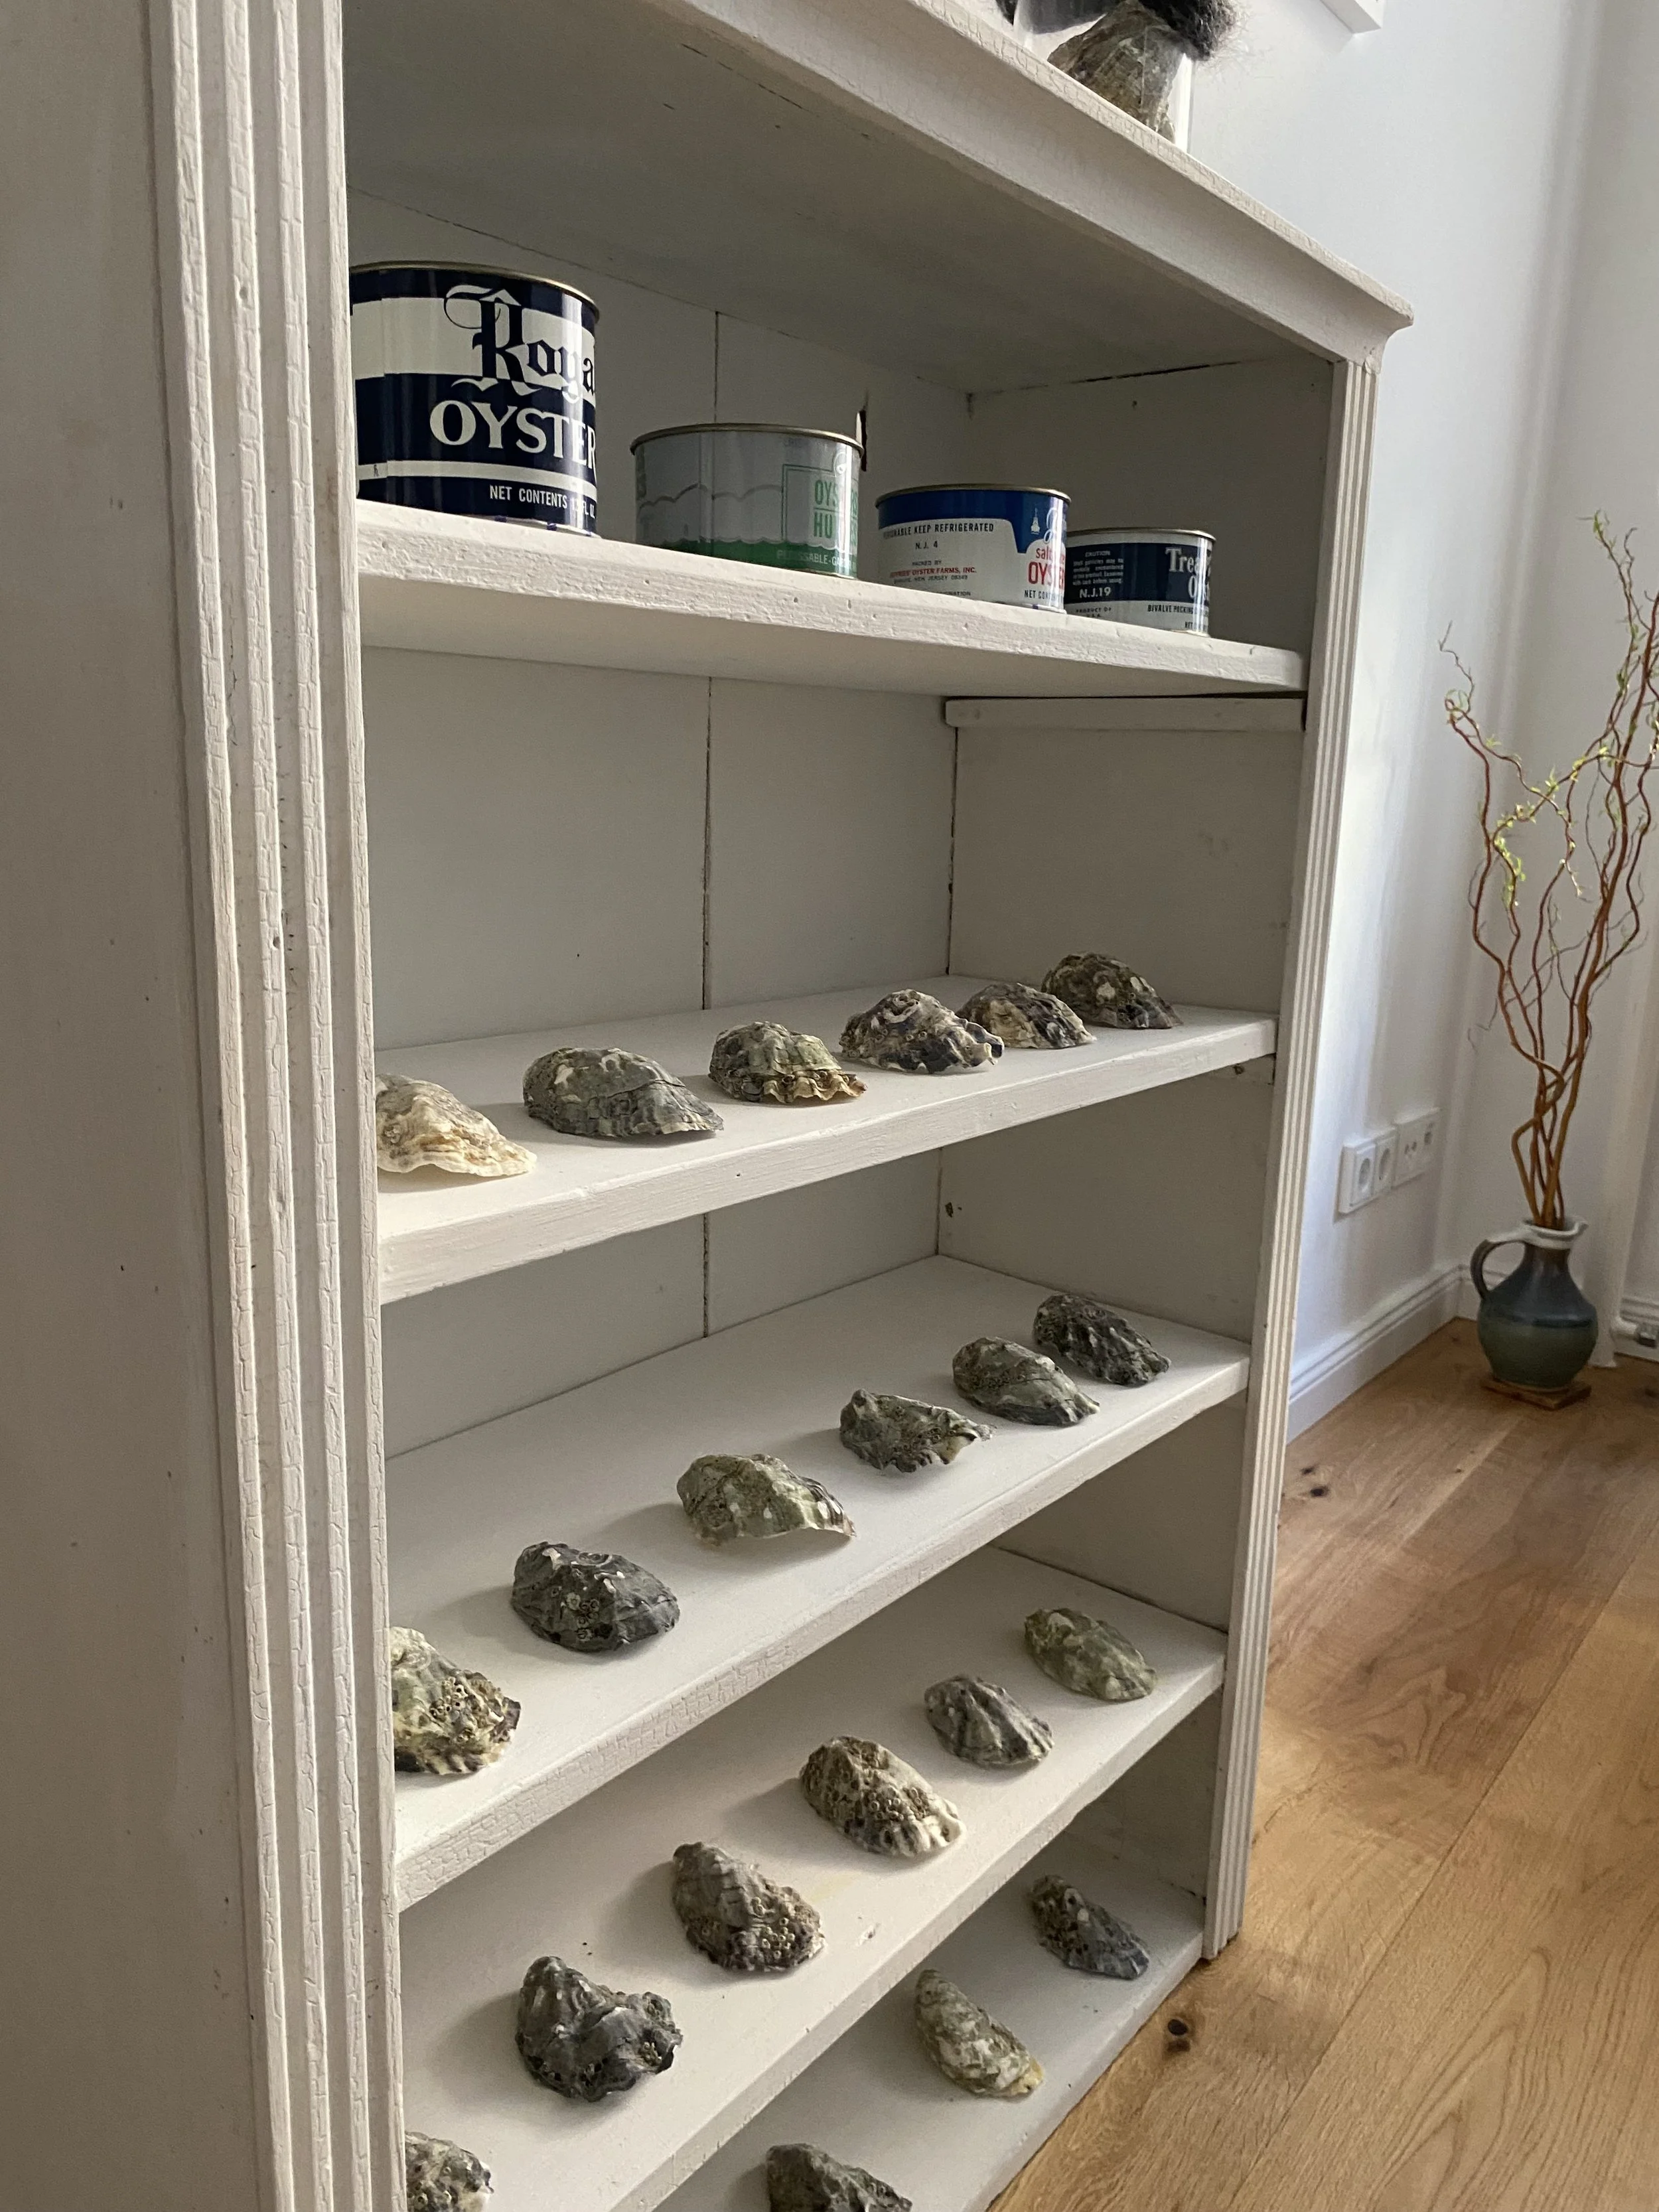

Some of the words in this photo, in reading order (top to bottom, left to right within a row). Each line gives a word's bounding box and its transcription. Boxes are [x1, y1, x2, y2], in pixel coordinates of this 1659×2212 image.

[489, 484, 512, 500] NET
[519, 488, 567, 509] CONTENTS
[914, 524, 931, 534] KEEP
[934, 523, 994, 533] REFRIGERATED
[1025, 589, 1036, 599] NET
